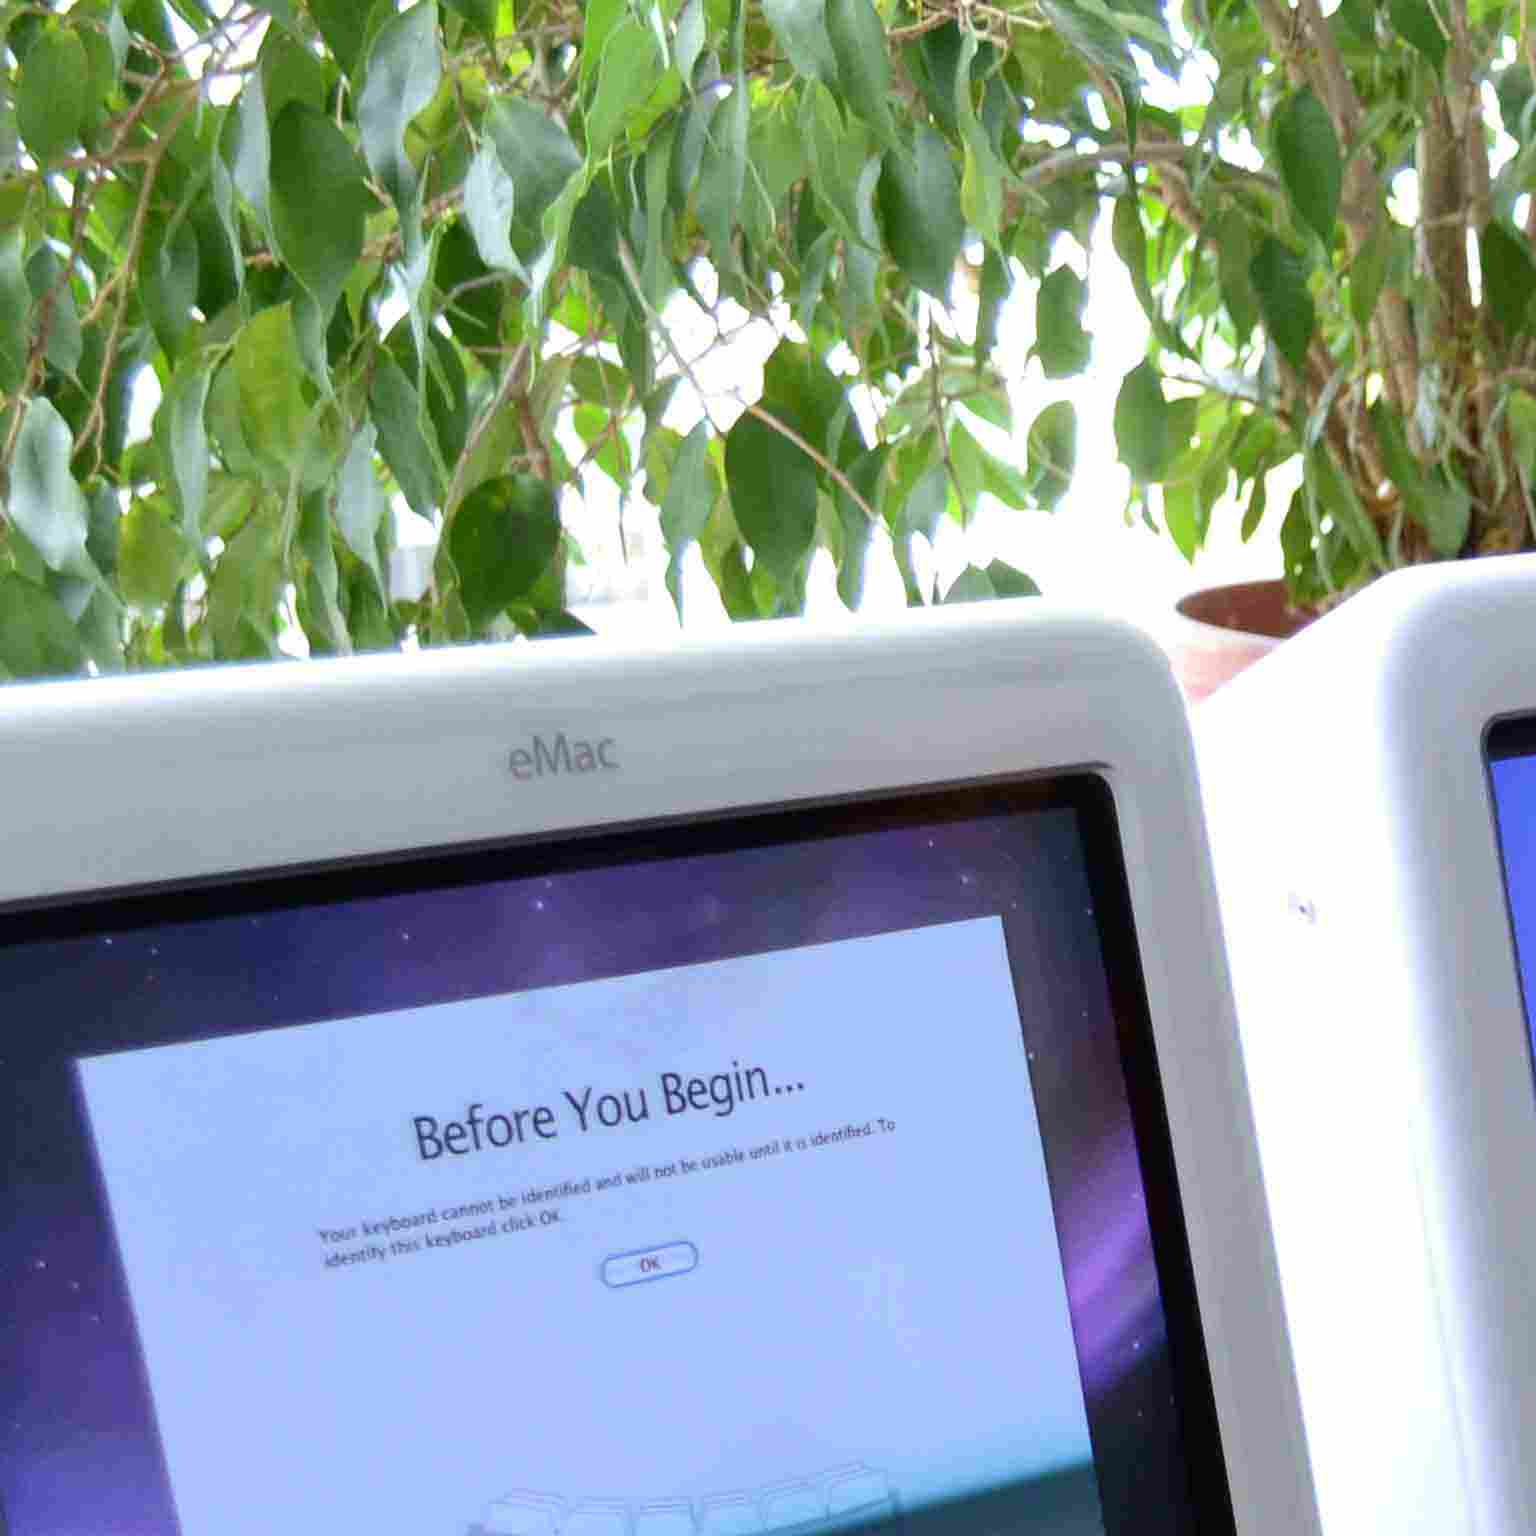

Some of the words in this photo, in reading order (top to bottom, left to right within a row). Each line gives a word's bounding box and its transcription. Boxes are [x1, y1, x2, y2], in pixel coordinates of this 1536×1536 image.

[508, 732, 620, 781] eMac
[413, 1104, 558, 1161] Before
[562, 1087, 650, 1133] You
[660, 1061, 805, 1118] Begin...
[319, 1226, 358, 1244] Your
[362, 1207, 438, 1238] keyboard
[441, 1200, 495, 1222] cannot
[498, 1193, 518, 1211] be
[521, 1179, 591, 1205] identified
[596, 1173, 622, 1191] and
[626, 1166, 650, 1185] will
[654, 1161, 677, 1179] not
[680, 1157, 698, 1174] be
[701, 1148, 745, 1170] usable
[749, 1140, 780, 1161] until
[783, 1139, 793, 1154] it
[796, 1136, 808, 1151] is
[876, 1117, 896, 1133] To
[324, 1243, 385, 1269] identify
[390, 1238, 420, 1257] this
[425, 1220, 497, 1251] keyboard
[501, 1211, 534, 1233] click
[640, 1256, 662, 1273] OK
